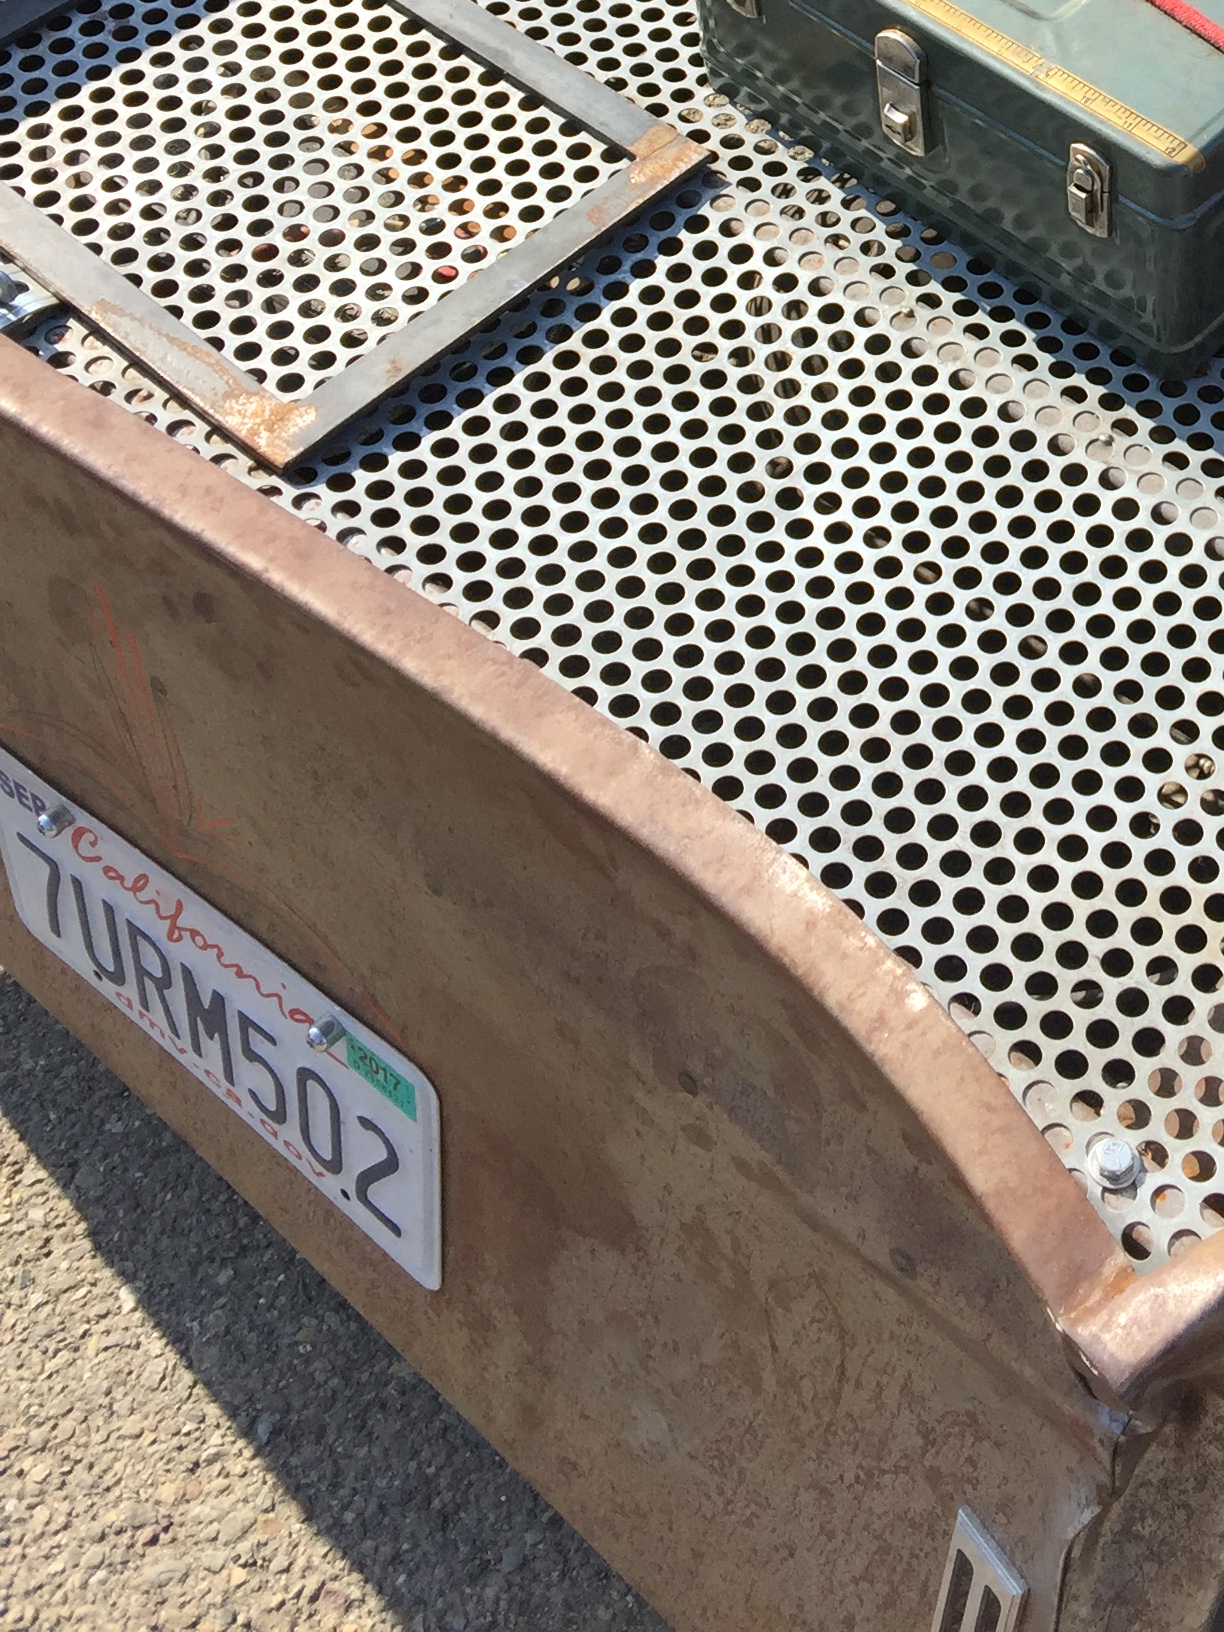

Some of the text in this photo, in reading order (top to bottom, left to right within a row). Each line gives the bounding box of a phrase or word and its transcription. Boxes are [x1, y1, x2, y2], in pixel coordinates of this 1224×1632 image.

[1164, 146, 1176, 156] 12
[71, 826, 317, 1028] California
[16, 831, 403, 1238] 7URM502
[115, 991, 327, 1178] dmv.ca.gov
[358, 1046, 401, 1091] 2017
